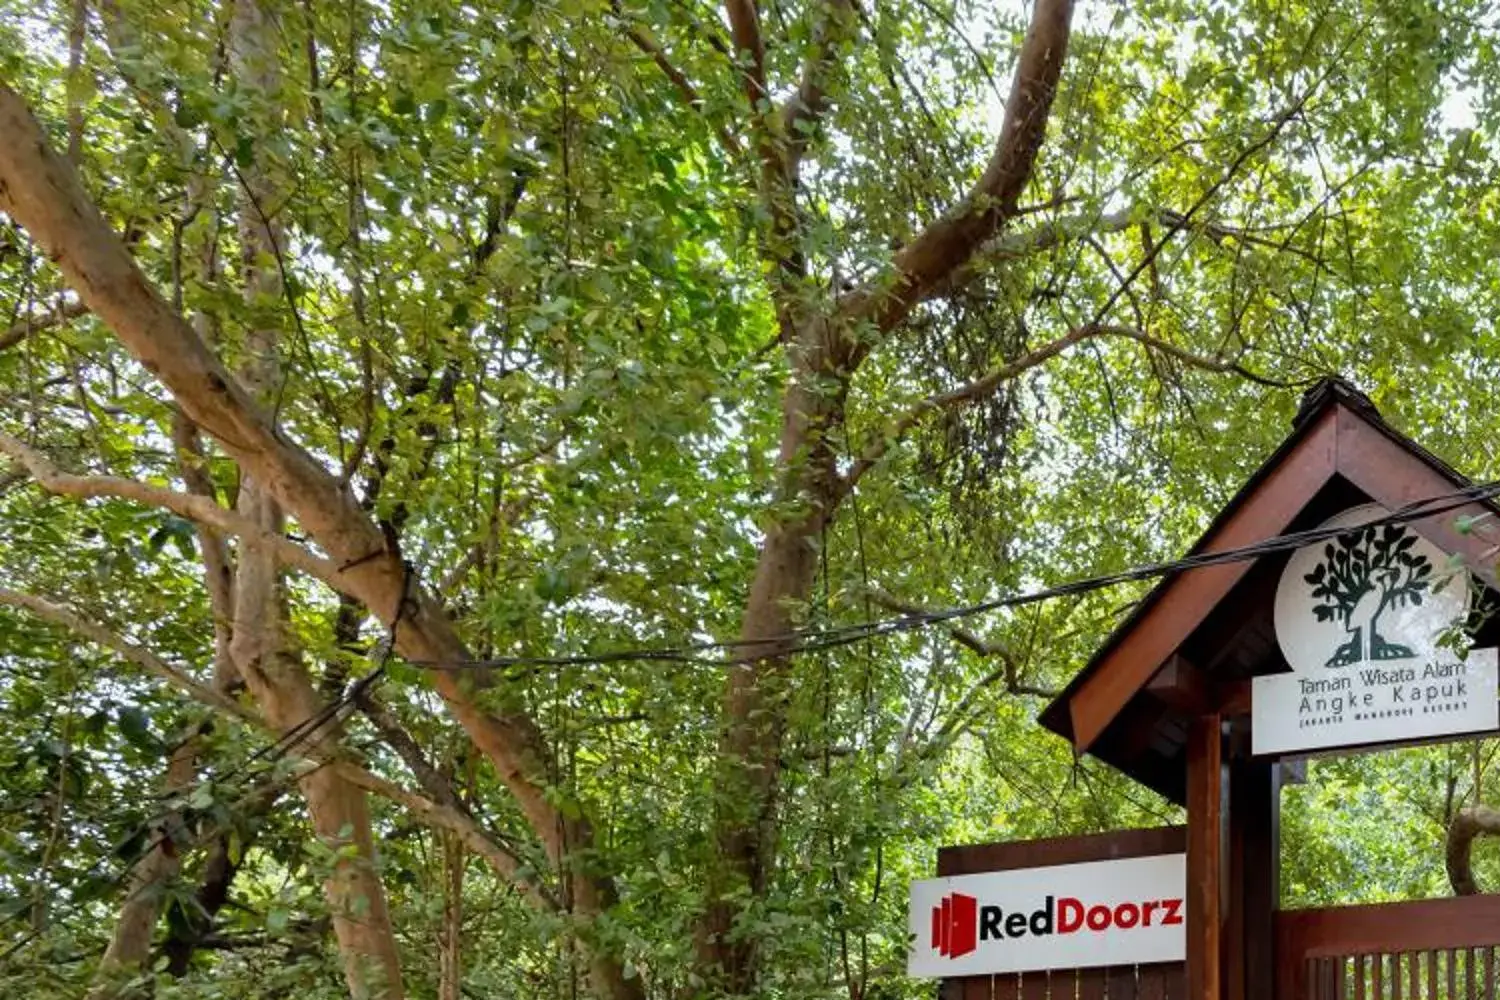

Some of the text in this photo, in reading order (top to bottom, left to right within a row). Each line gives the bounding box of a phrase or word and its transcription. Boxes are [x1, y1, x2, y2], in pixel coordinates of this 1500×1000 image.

[1298, 660, 1467, 695] Taman Wisata Alam
[1299, 679, 1468, 715] Angke Kapuk
[979, 896, 1183, 940] RedDoorz
